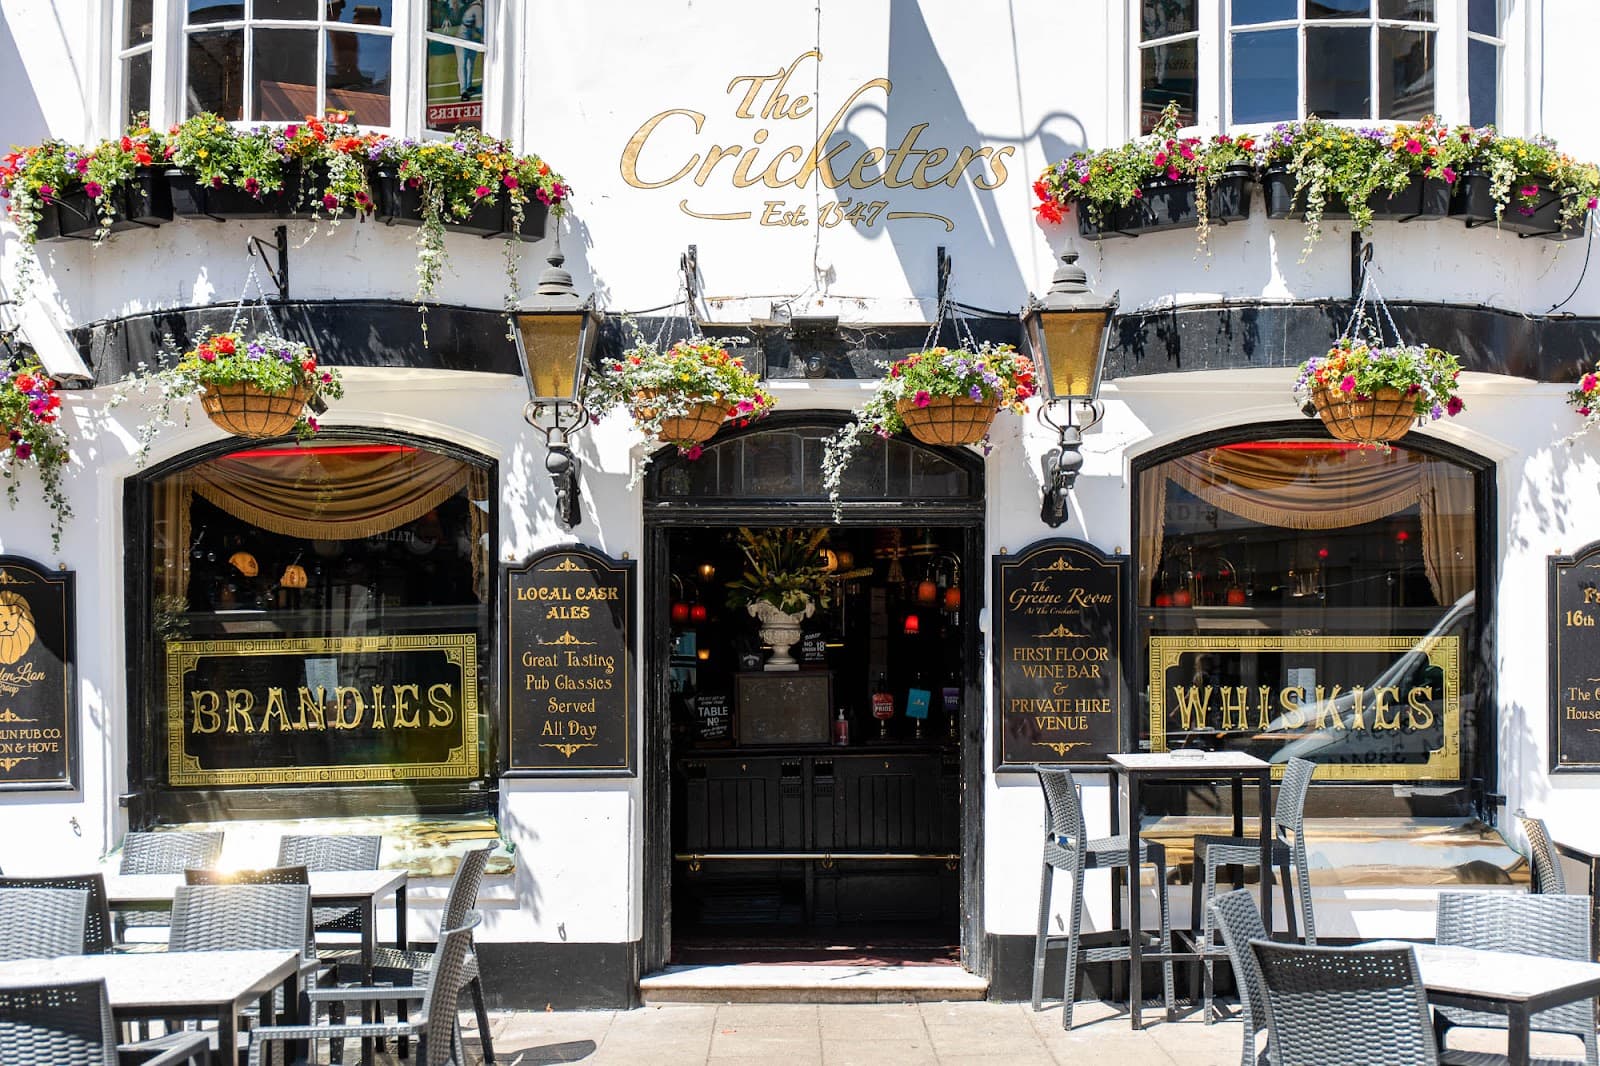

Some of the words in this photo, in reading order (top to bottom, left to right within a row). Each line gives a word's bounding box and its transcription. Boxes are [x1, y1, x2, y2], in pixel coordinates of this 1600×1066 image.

[727, 51, 822, 120] The
[620, 78, 1016, 190] Cricketers
[760, 200, 809, 228] Est.
[817, 197, 889, 228] 1547
[1031, 576, 1053, 592] The
[517, 587, 571, 600] LOCAL
[576, 586, 619, 600] CASK
[1008, 588, 1063, 611] Greene
[1068, 587, 1113, 608] Room
[546, 606, 591, 620] ALES
[1566, 610, 1595, 627] 16th
[1013, 647, 1052, 661] FIRST
[1055, 647, 1109, 661] FLOOR
[522, 652, 557, 668] Great
[564, 651, 615, 674] Tasting
[14, 662, 46, 683] Lion
[1022, 665, 1064, 679] WINE
[1067, 665, 1100, 679] BAR
[525, 674, 550, 690] Pub
[555, 674, 612, 690] Classics
[1053, 682, 1068, 696] &
[1568, 688, 1591, 701] The
[191, 682, 456, 735] BRANDIES
[547, 697, 596, 713] Served
[697, 706, 729, 719] TABLE
[1011, 699, 1072, 713] PRIVATE
[1075, 699, 1111, 713] HIRE
[1173, 683, 1435, 732] WHISKIES
[541, 721, 563, 736] All
[568, 720, 597, 740] Day
[1035, 715, 1089, 730] VENUE
[0, 729, 18, 739] UN
[19, 729, 42, 740] PUB
[42, 728, 62, 739] CO.
[15, 742, 26, 753] &
[27, 742, 59, 753] HOVE
